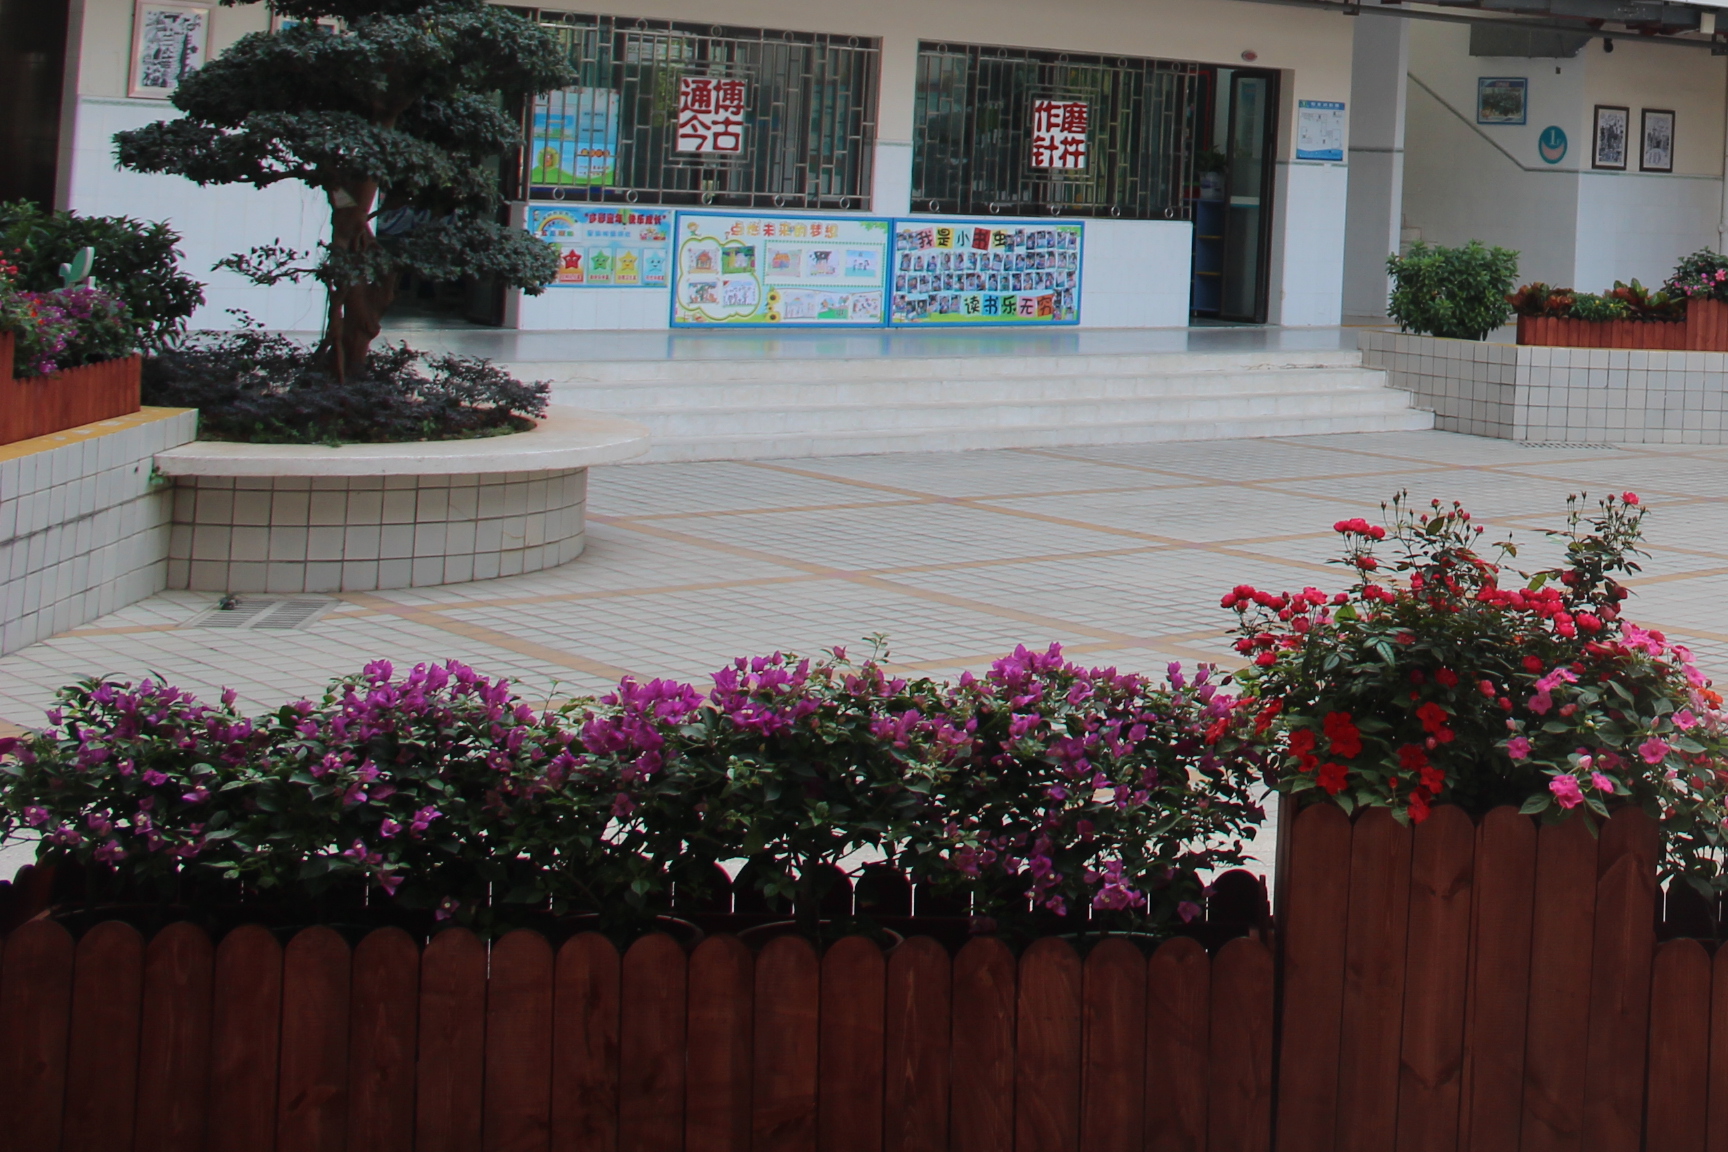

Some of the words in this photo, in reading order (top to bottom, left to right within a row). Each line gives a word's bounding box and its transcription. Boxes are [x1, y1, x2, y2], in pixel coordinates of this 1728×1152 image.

[917, 227, 1008, 250] 我是小书虫
[964, 295, 1054, 316] 读书乐无穷
